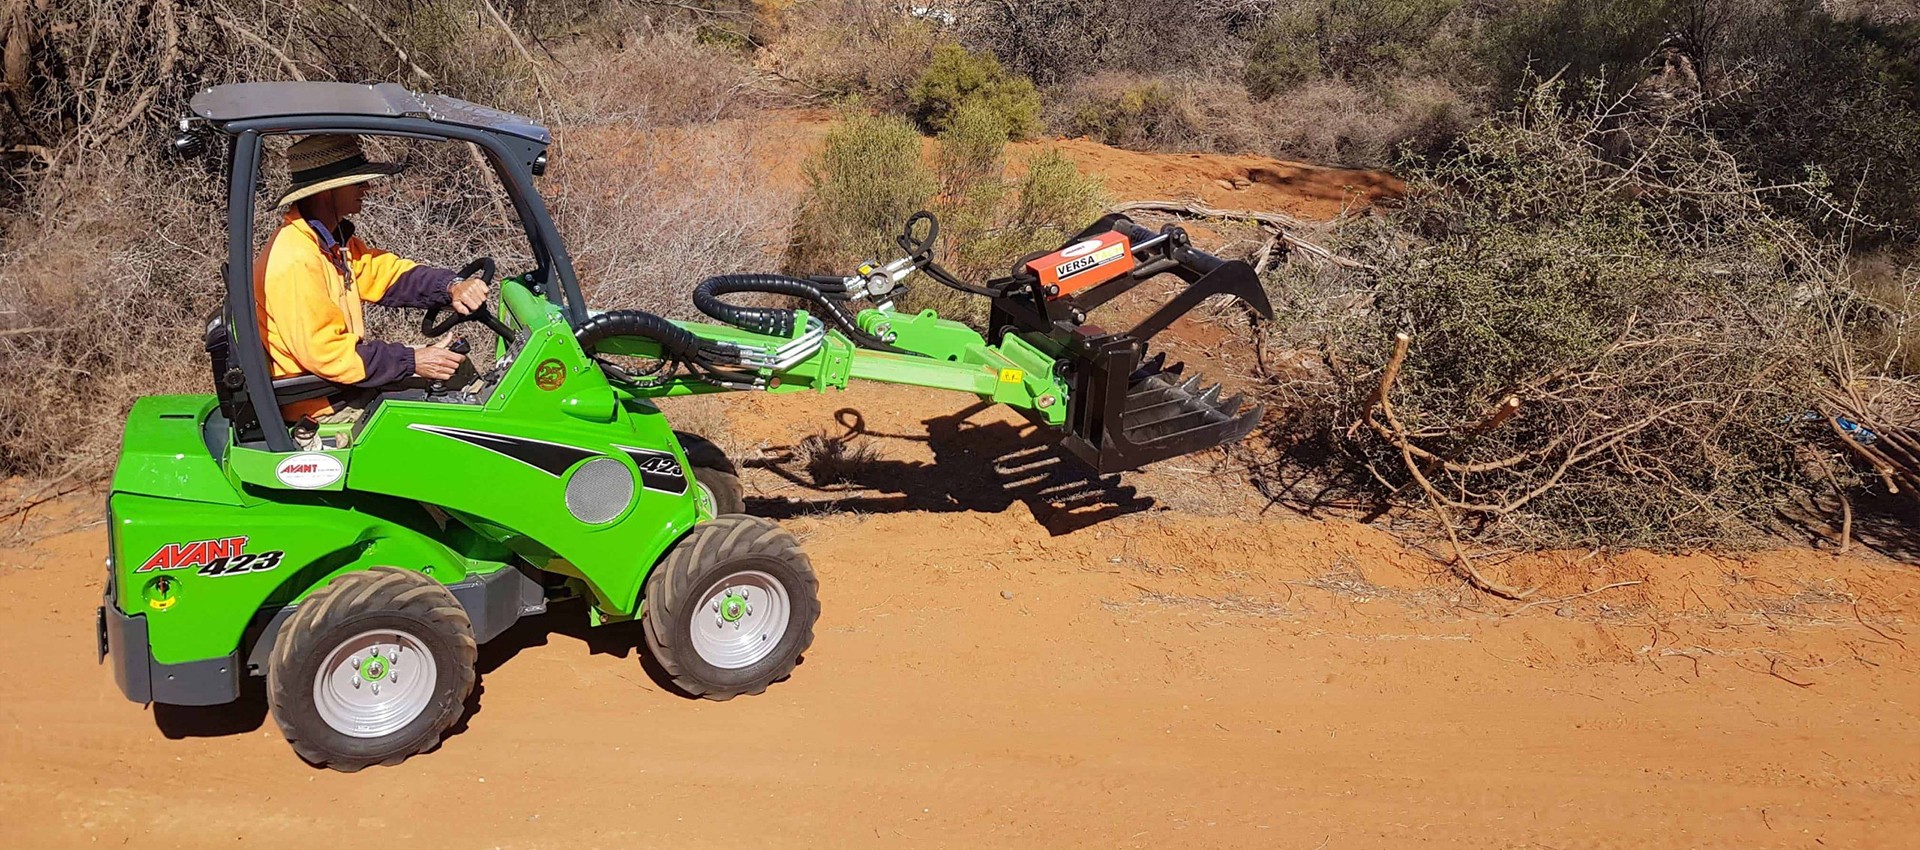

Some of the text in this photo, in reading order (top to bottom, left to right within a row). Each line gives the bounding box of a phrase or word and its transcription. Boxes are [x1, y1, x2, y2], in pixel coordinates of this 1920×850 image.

[280, 464, 318, 474] AVANT
[135, 536, 249, 573] AVANT
[197, 550, 285, 577] 423
